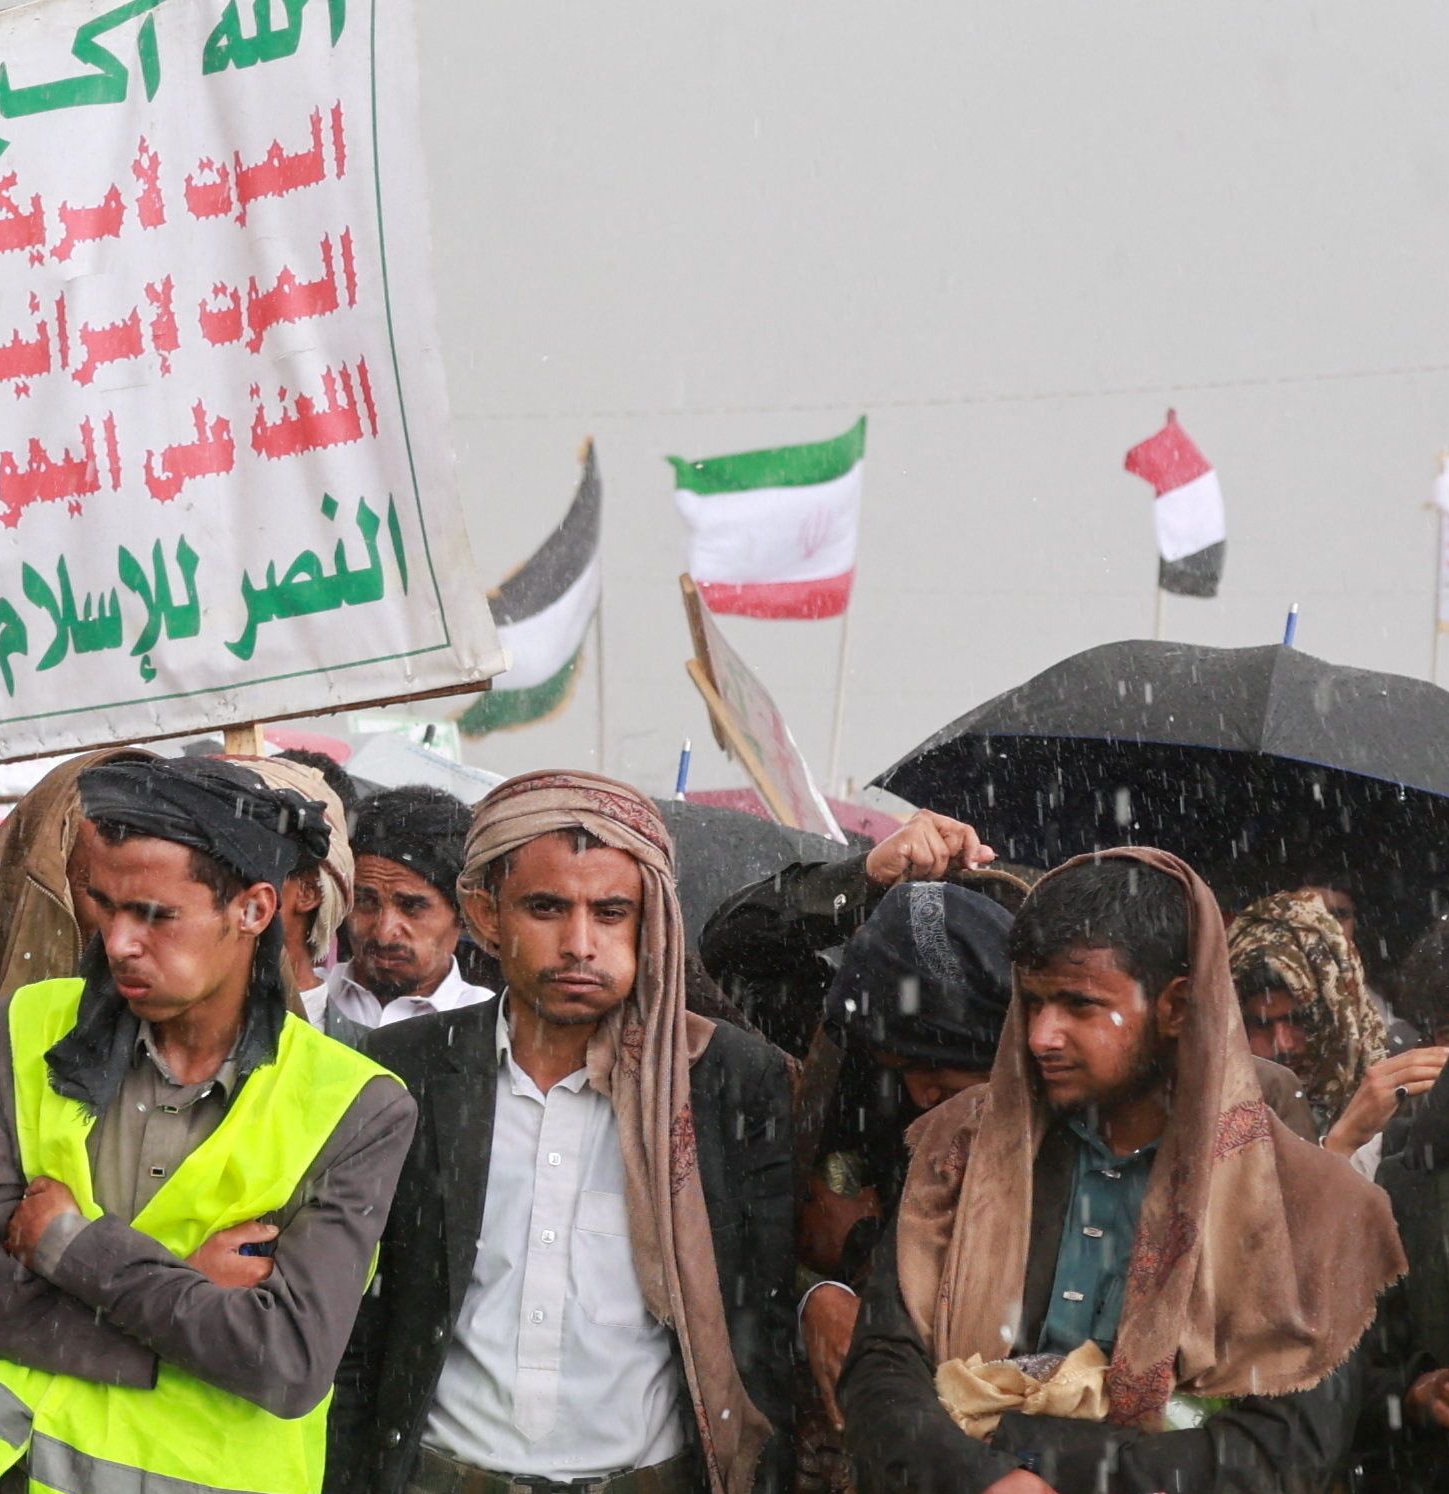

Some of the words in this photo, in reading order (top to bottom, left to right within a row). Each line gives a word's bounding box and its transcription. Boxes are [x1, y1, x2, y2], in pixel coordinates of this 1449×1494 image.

[184, 99, 347, 228] الموت
[199, 225, 358, 354] الموت
[144, 397, 236, 503] على
[250, 353, 379, 460] اللعنة
[224, 491, 409, 660] النصر
